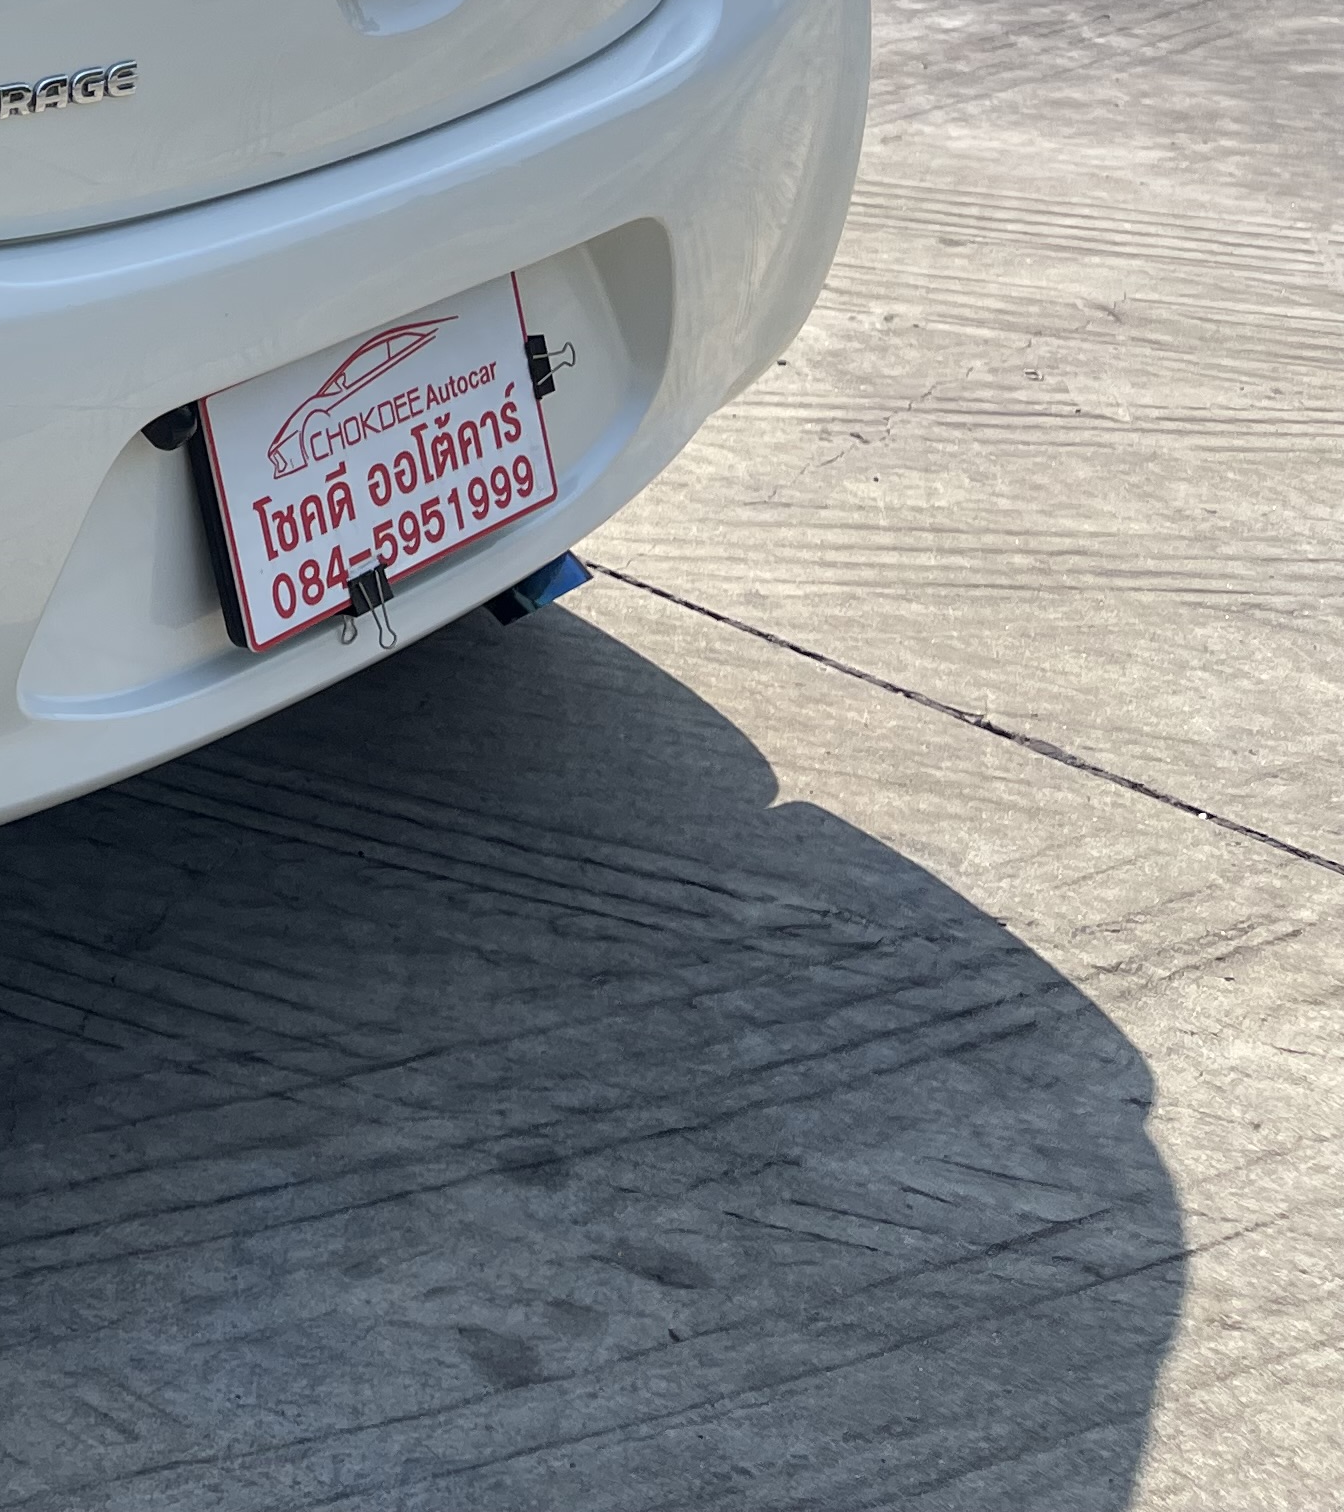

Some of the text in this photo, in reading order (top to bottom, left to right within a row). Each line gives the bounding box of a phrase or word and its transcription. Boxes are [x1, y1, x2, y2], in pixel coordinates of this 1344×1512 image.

[253, 381, 523, 561] โชคดี ออโต้คาร์
[309, 361, 498, 462] CHOKDEE Autocar
[272, 454, 535, 619] 084-5951999
